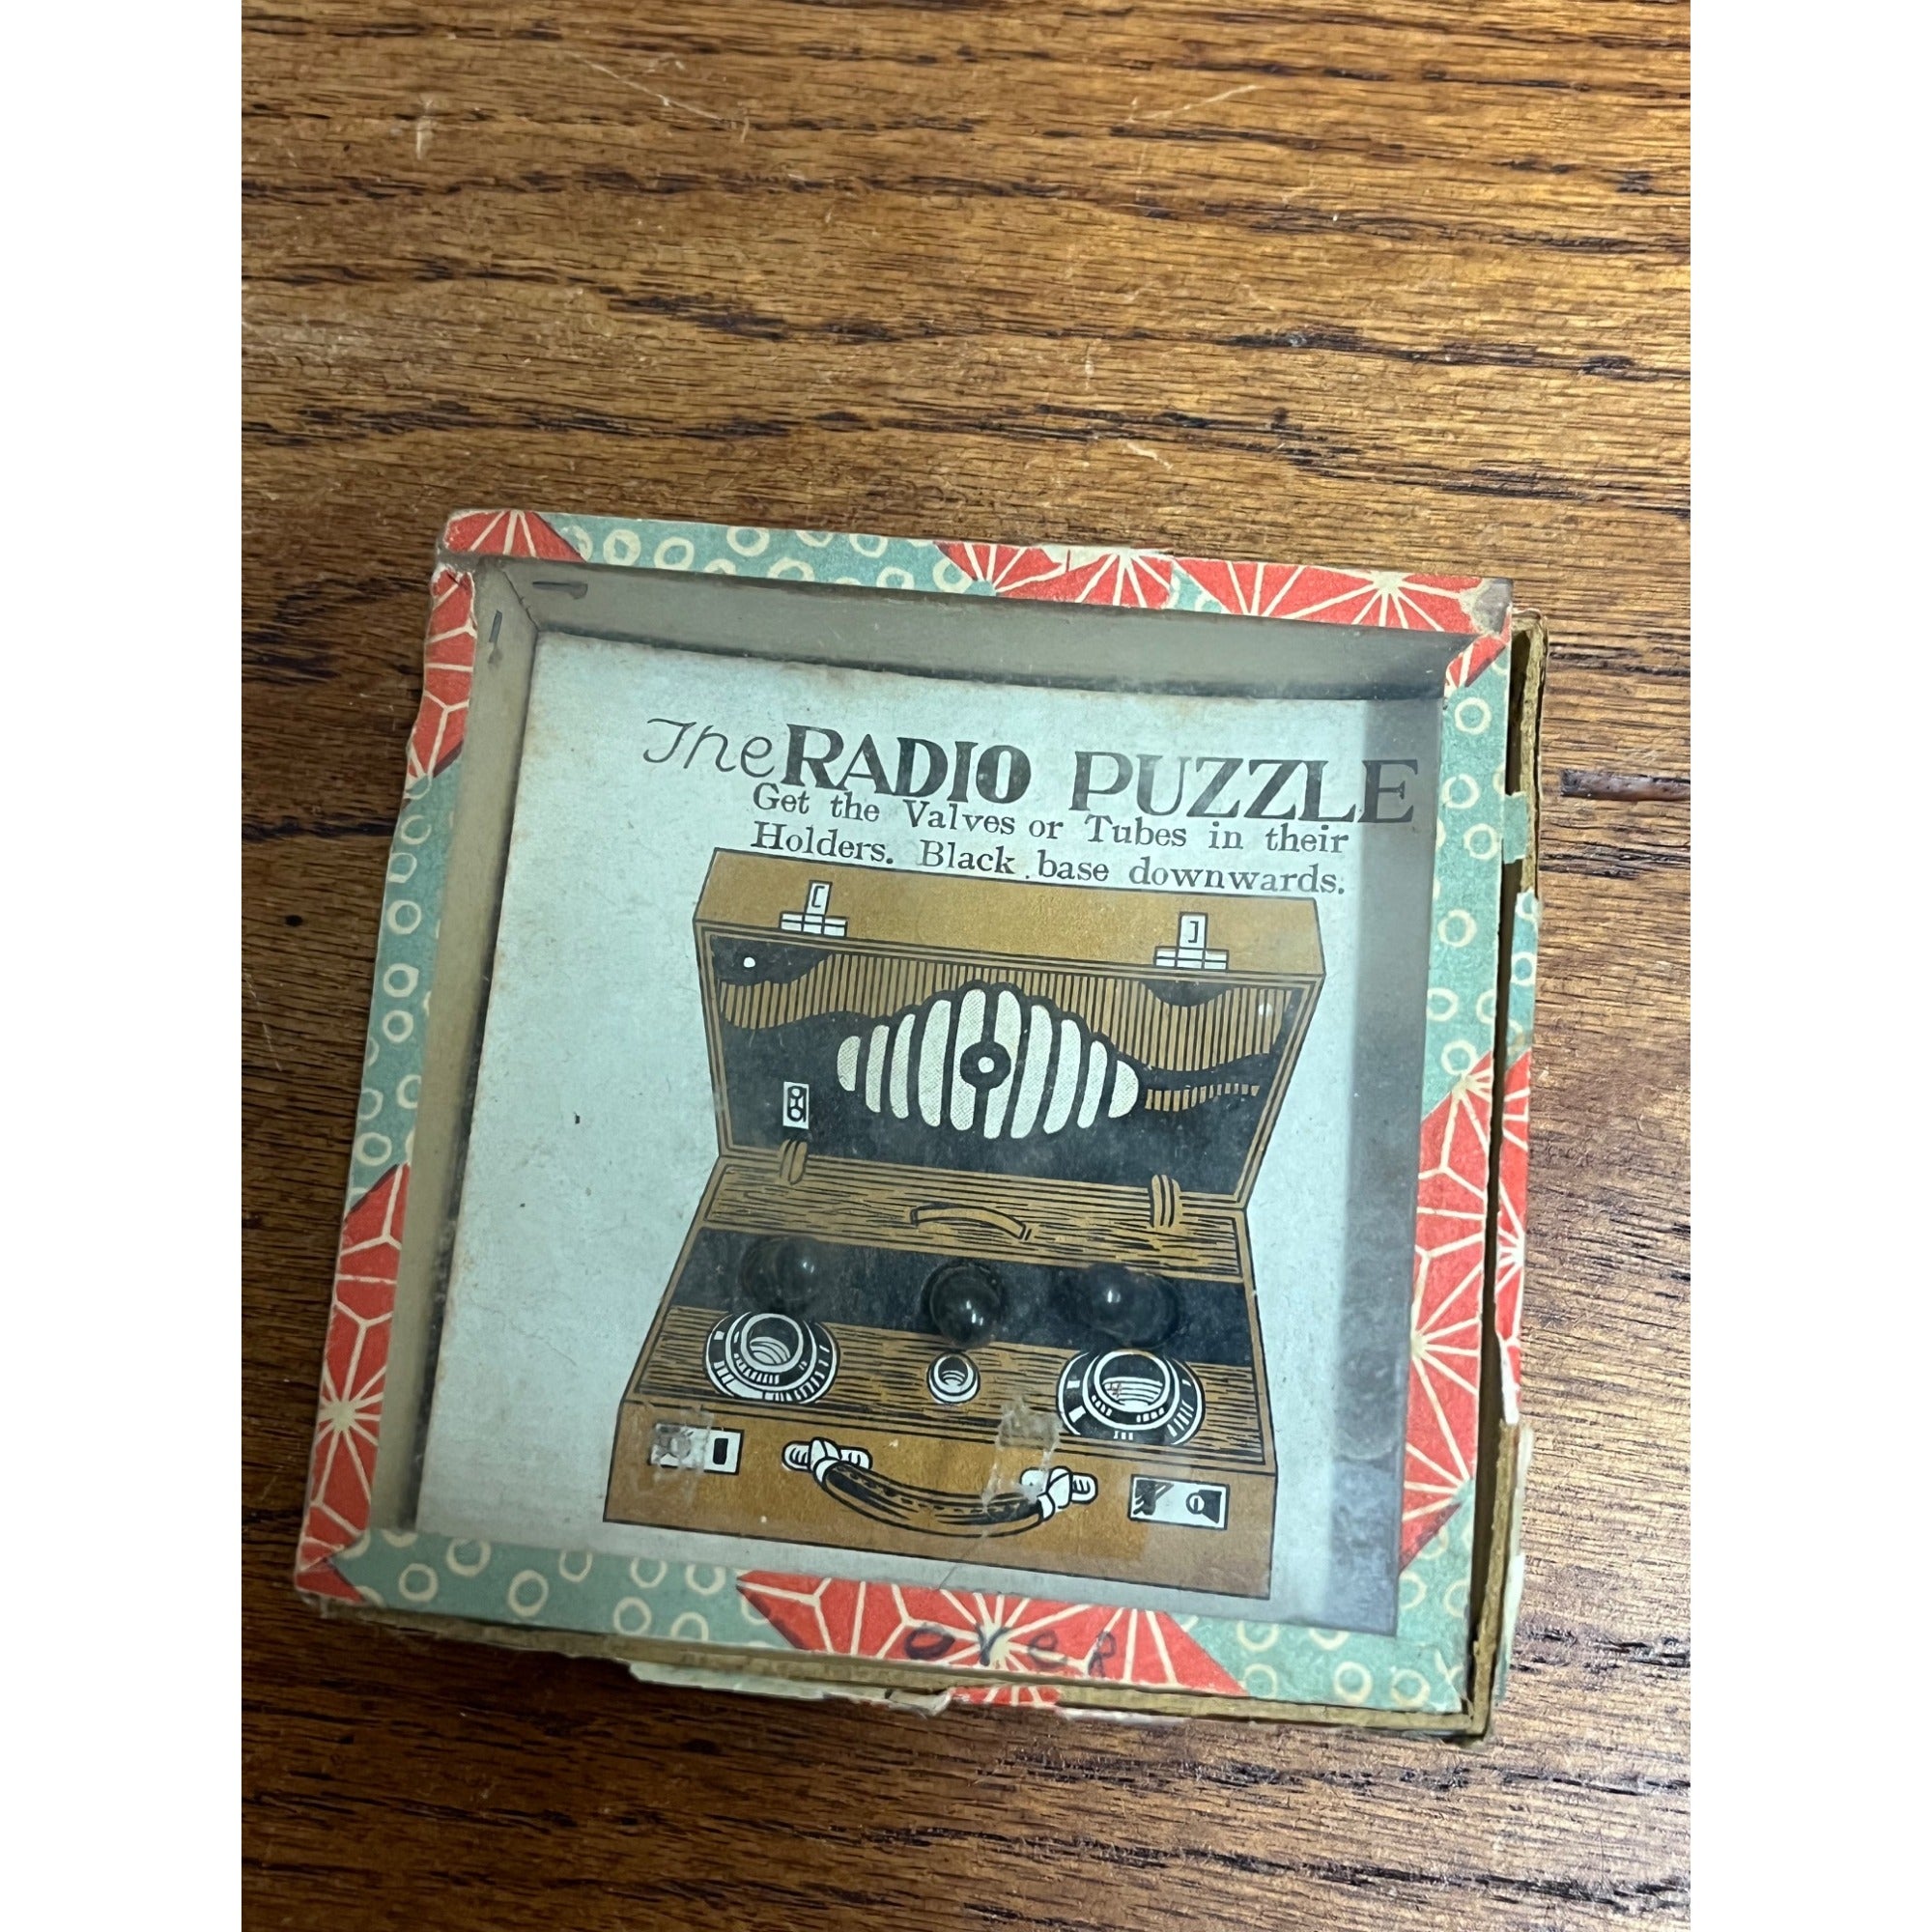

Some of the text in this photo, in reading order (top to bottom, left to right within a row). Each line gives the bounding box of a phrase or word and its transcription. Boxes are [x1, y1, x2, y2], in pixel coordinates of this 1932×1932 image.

[642, 718, 1419, 824] The RADIO PUZZLE
[753, 782, 1350, 854] Get the Valves or Tubes in their
[751, 820, 1346, 895] Holders. Black base downwards.
